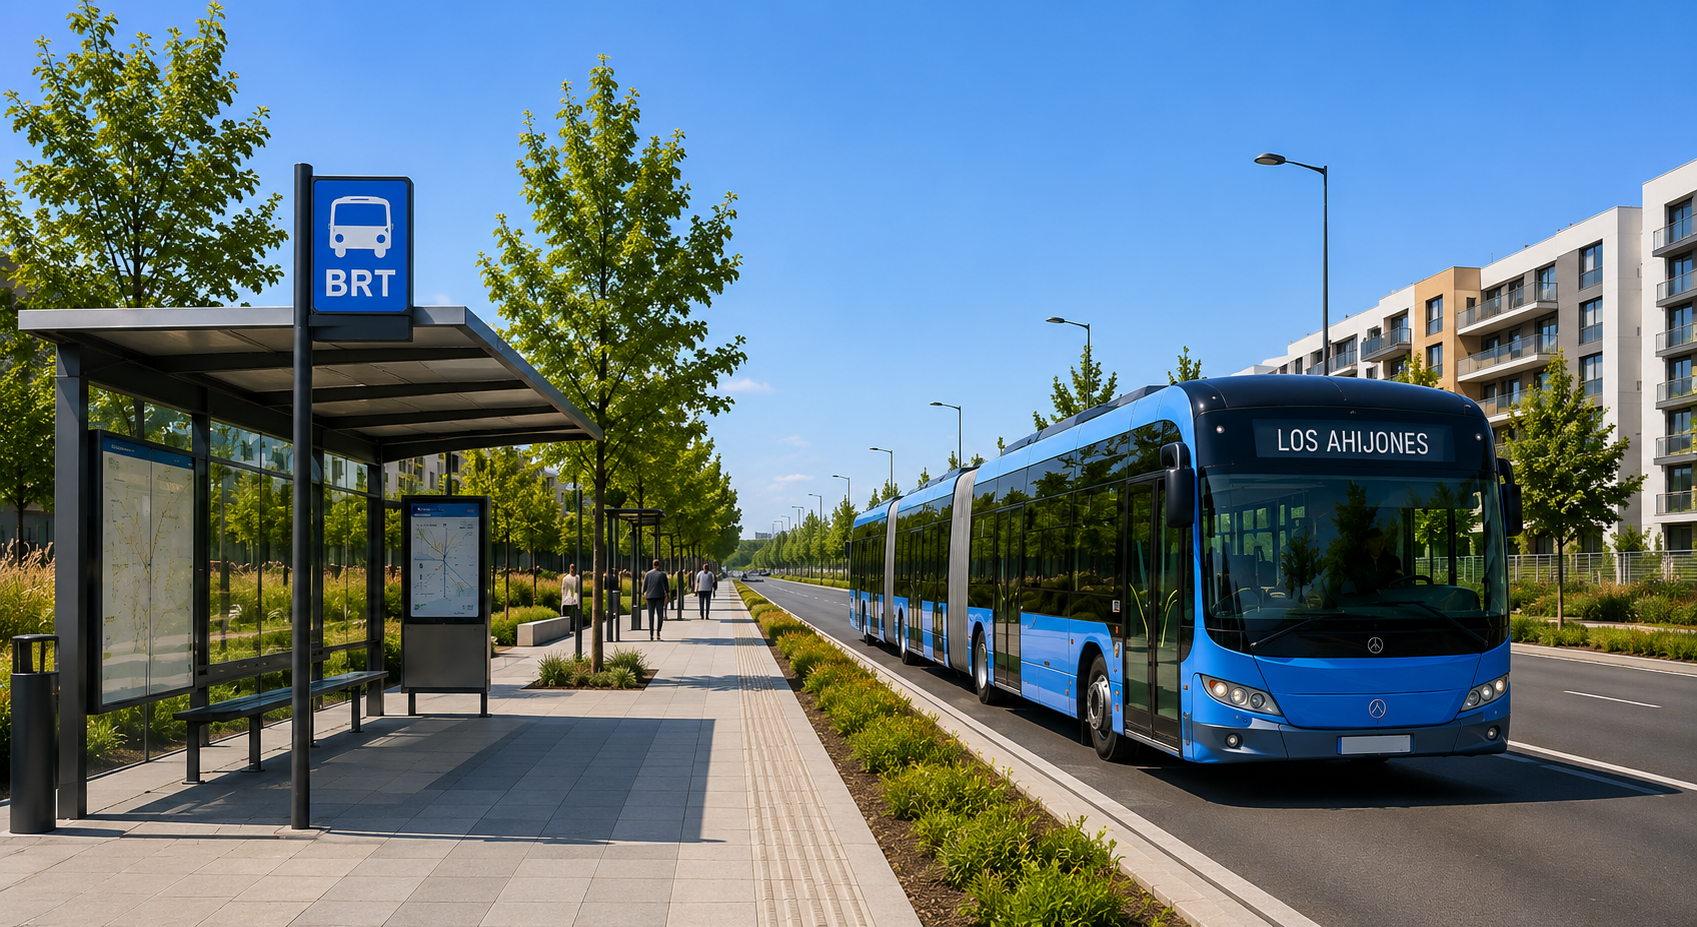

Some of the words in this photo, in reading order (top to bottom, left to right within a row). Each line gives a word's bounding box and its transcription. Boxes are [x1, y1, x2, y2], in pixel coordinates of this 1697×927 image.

[325, 269, 396, 297] BRT
[1277, 428, 1319, 452] LOS
[1326, 430, 1429, 455] AHIJONES
